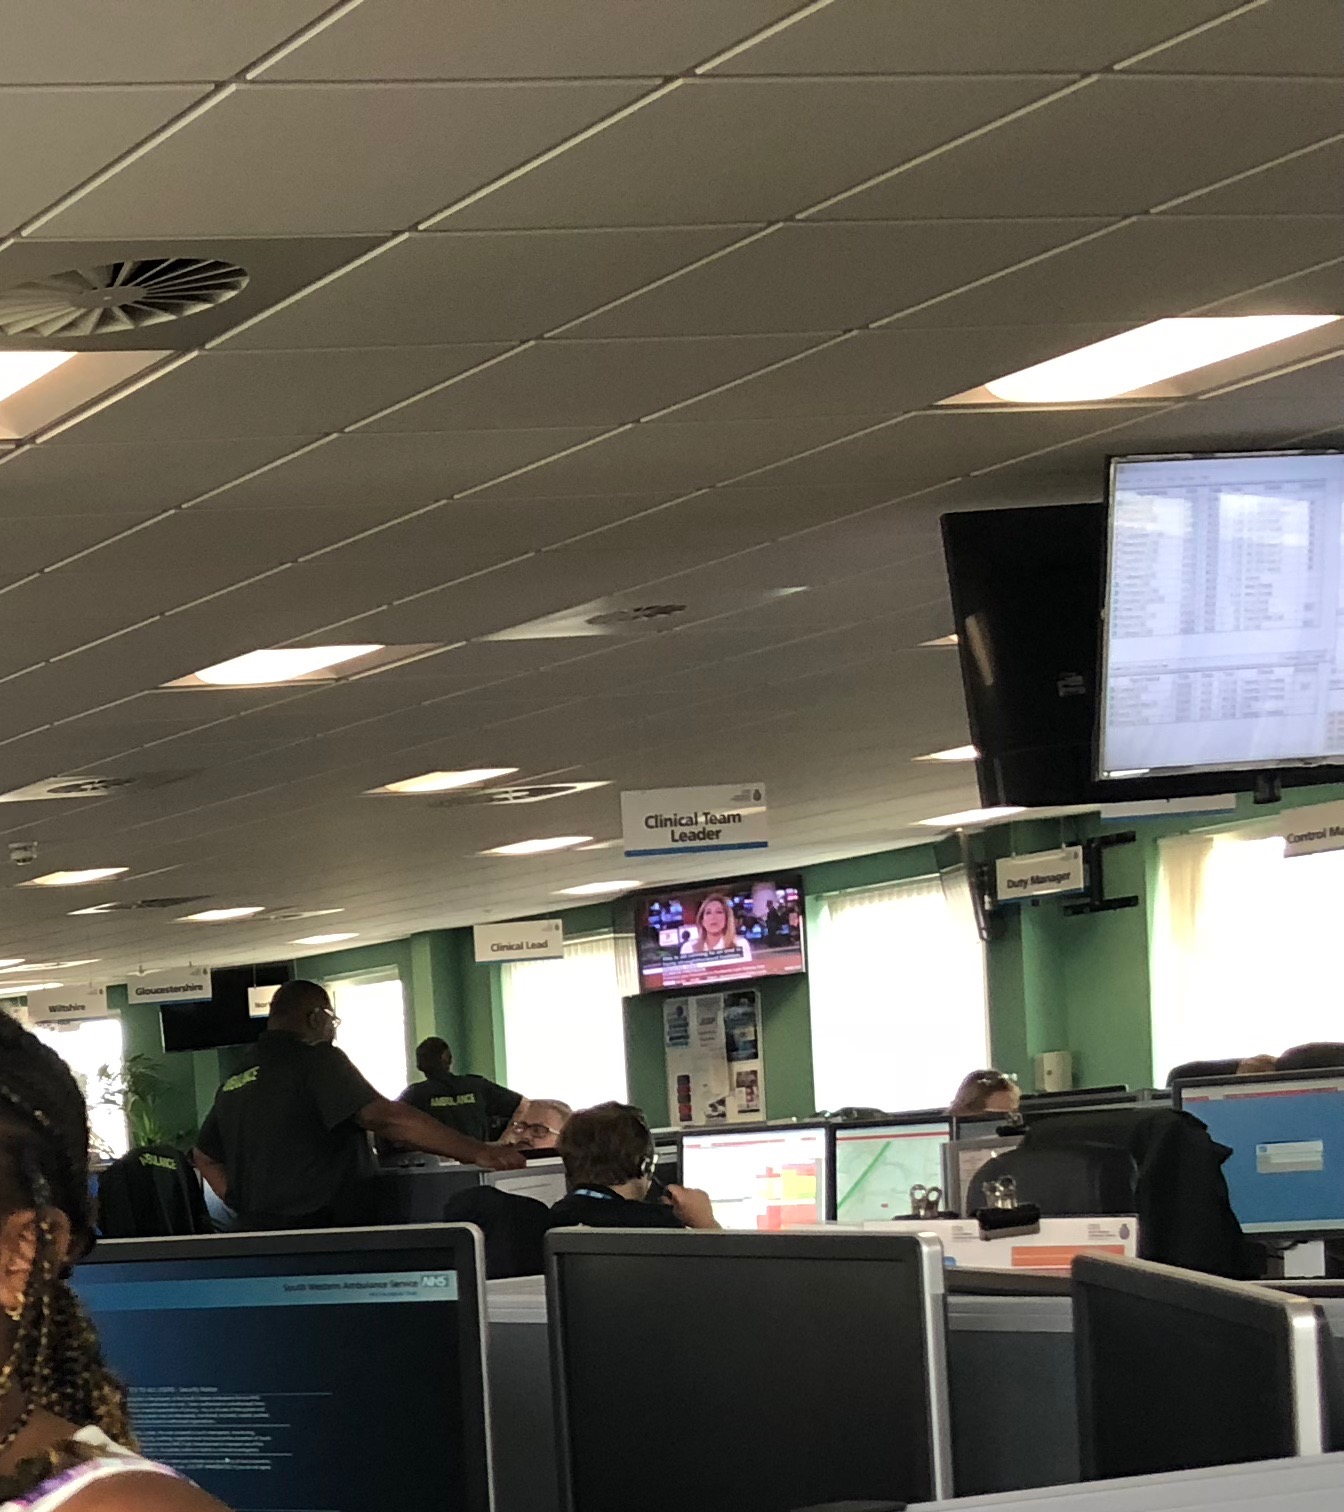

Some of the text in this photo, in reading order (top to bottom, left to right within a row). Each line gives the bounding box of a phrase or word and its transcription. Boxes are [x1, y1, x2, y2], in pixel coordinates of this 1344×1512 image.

[644, 811, 742, 829] Clinical Team
[670, 827, 722, 843] Leader
[1287, 827, 1326, 844] Control
[1006, 872, 1071, 889] Duty Manager
[490, 939, 548, 952] Clinical Lead
[135, 982, 203, 996] Gloucestershire
[48, 1003, 86, 1014] Wiltshire
[342, 1281, 388, 1290] Ambulance
[390, 1280, 419, 1288] Service
[421, 1275, 447, 1287] NHS
